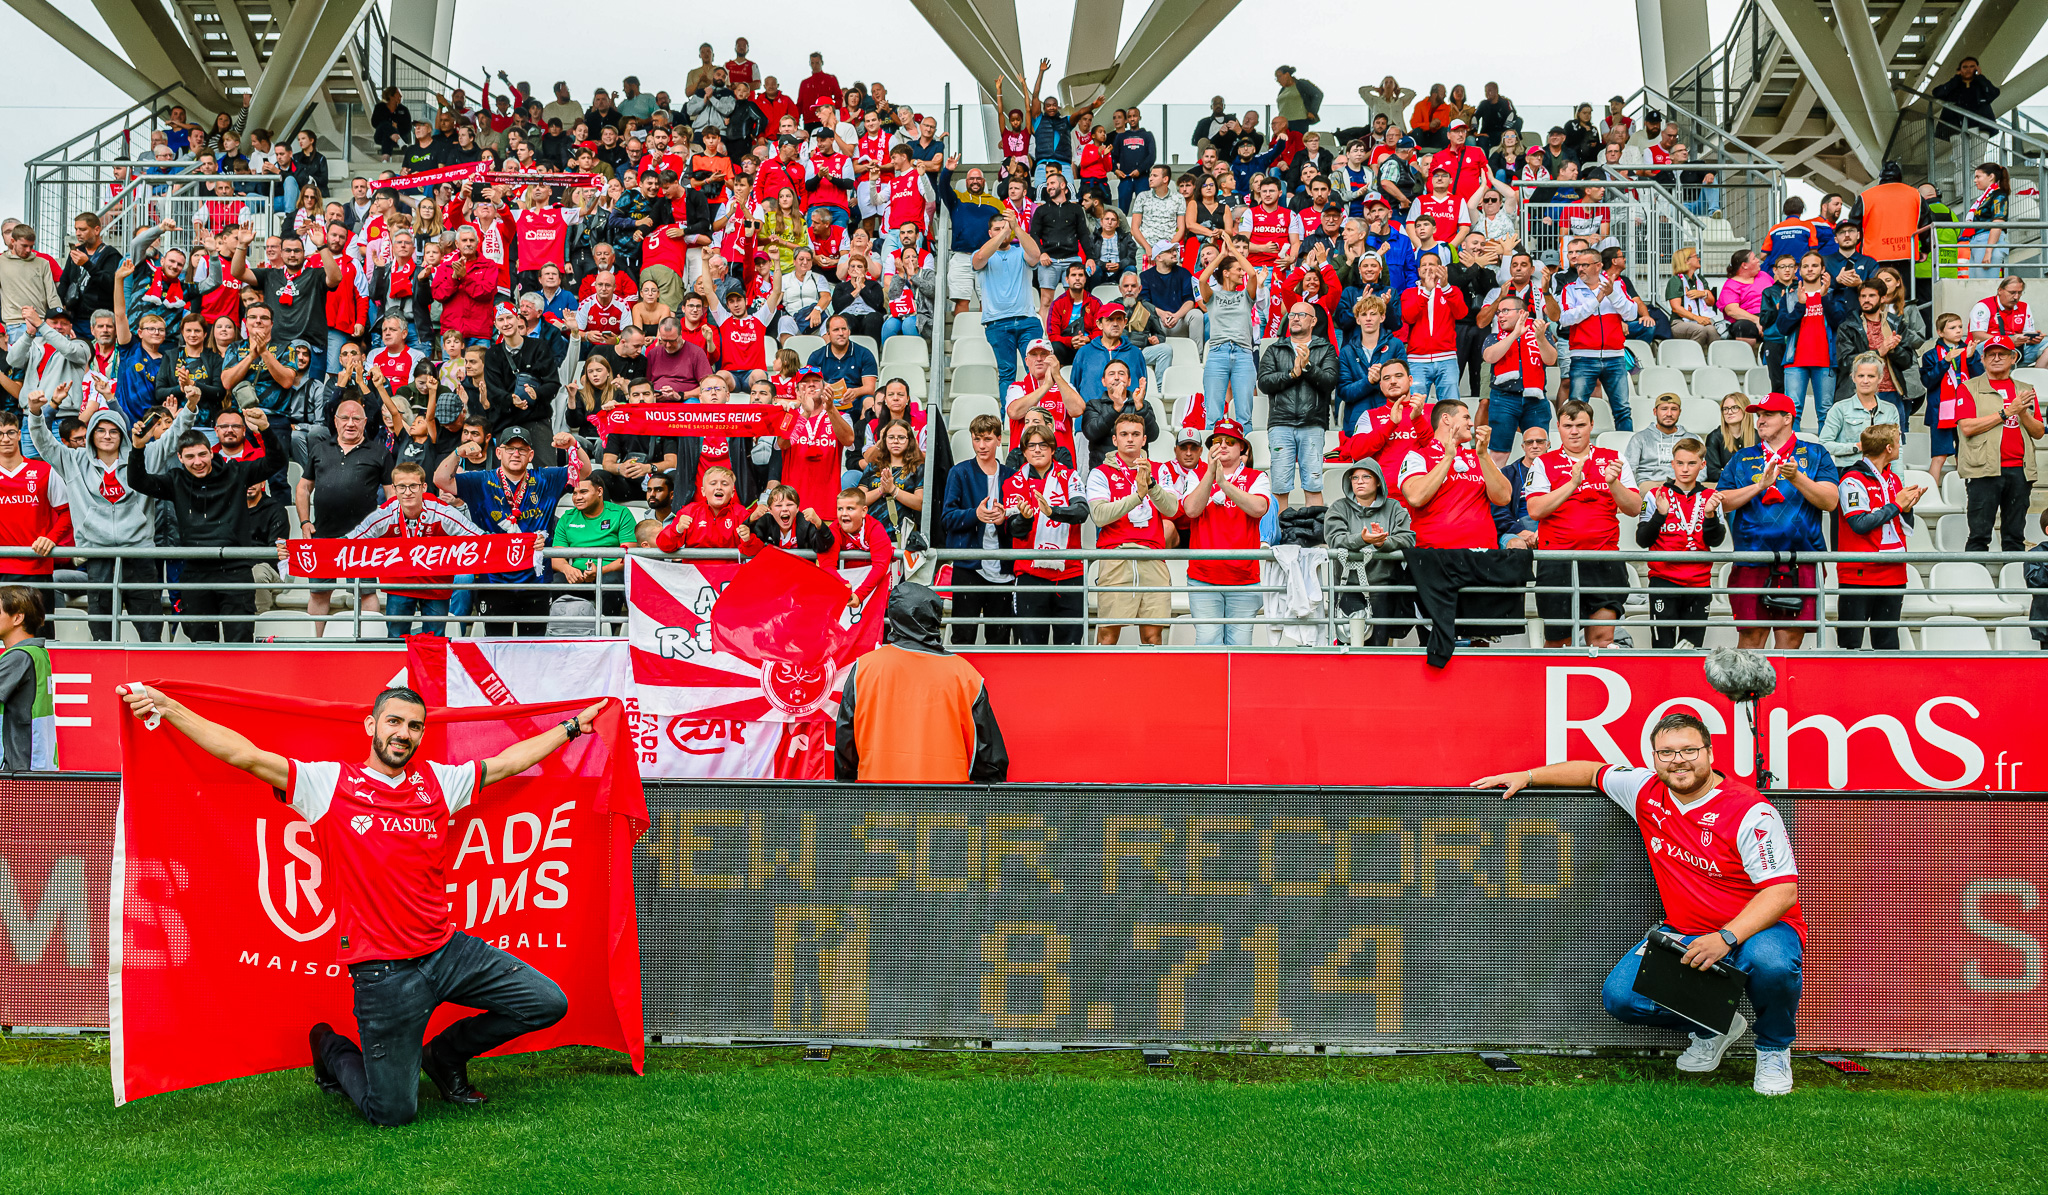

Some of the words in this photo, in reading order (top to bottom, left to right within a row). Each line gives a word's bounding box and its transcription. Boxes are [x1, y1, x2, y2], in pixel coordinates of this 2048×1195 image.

[648, 234, 660, 250] 5
[1881, 236, 1910, 245] SECURIT
[1525, 325, 1541, 366] STAD
[645, 411, 676, 422] NOUS
[677, 412, 726, 423] SOMMES
[728, 412, 762, 423] REIMS
[334, 546, 403, 572] ALLEZ
[409, 542, 480, 570] REIMS
[641, 713, 658, 764] TADE
[379, 817, 437, 833] YASUDA
[448, 800, 576, 870] ADE
[852, 811, 1064, 893] SOR
[1103, 814, 1574, 899] RECORD
[1666, 842, 1721, 873] YASUDA
[1765, 839, 1777, 870] Triangle
[446, 861, 569, 930] IMS
[240, 950, 354, 979] MAISO
[980, 920, 1404, 1033] 8.714
